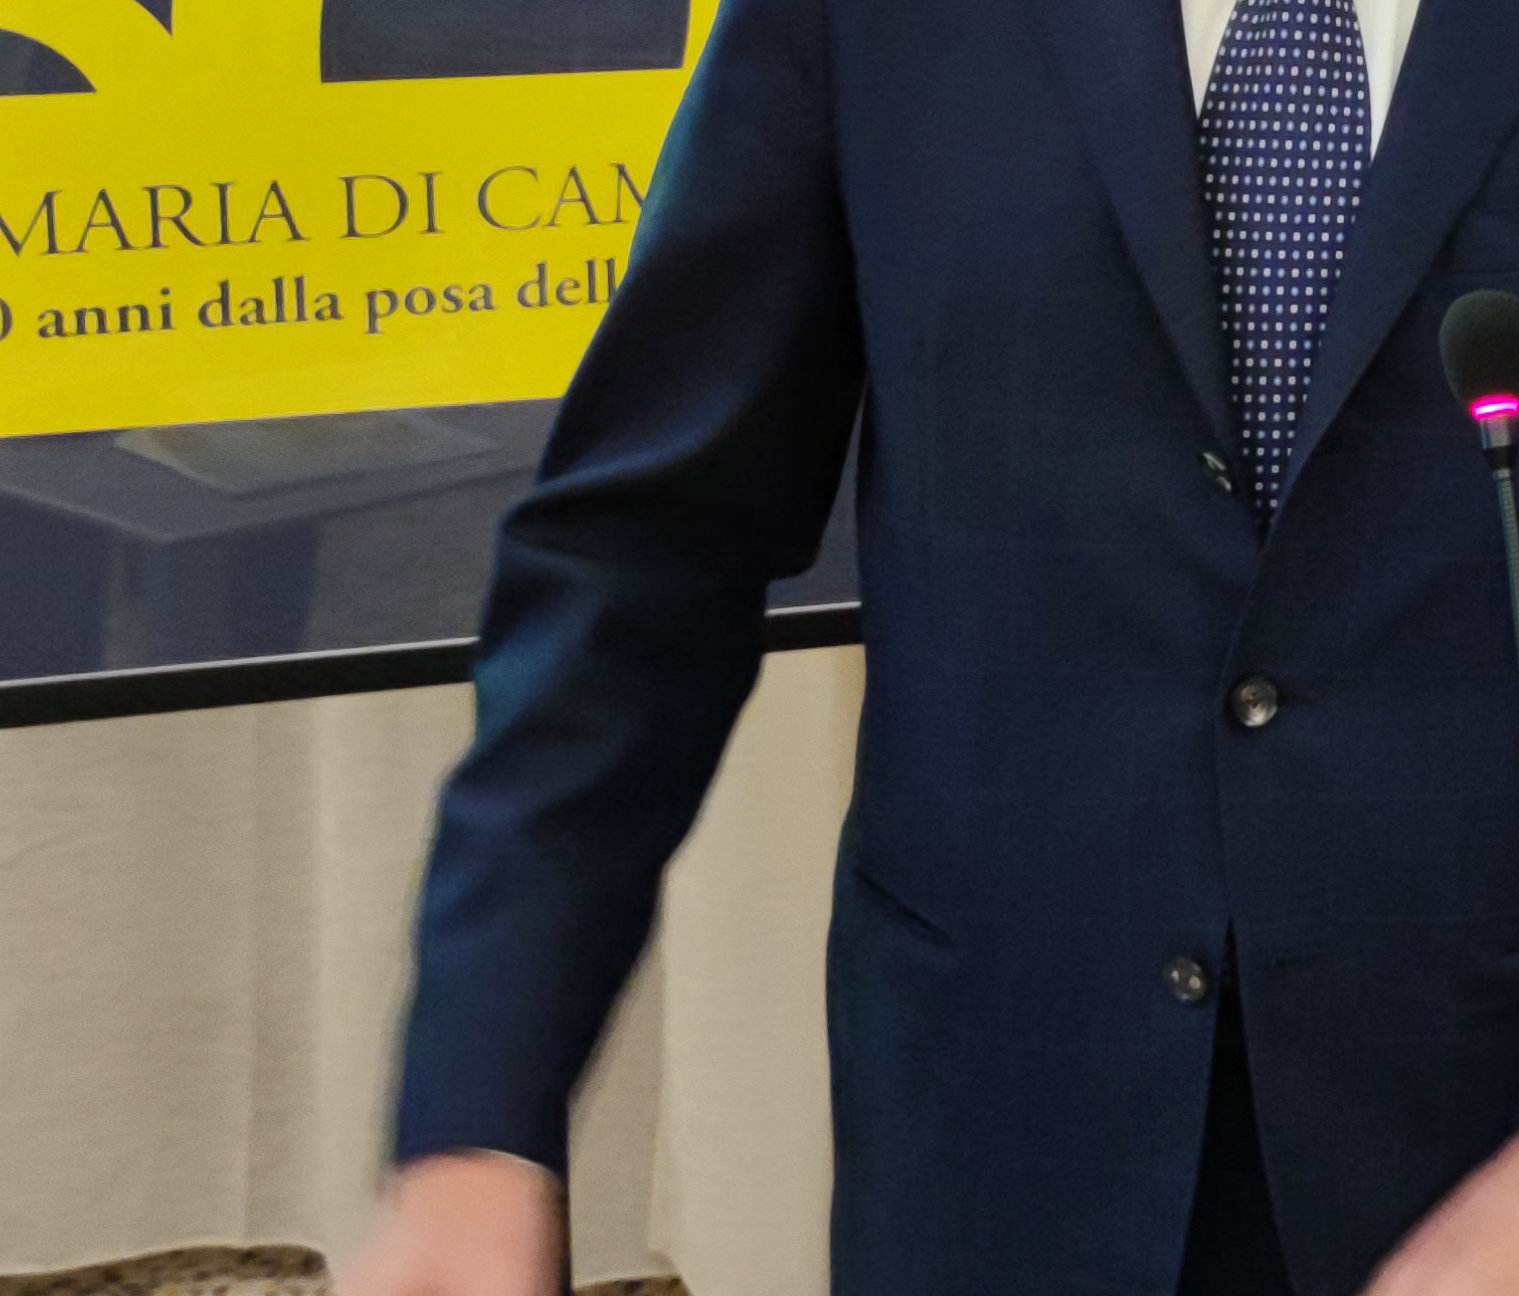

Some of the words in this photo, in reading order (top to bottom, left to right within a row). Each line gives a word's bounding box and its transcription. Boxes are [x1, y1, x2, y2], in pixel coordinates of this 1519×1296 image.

[339, 171, 444, 241] DI
[37, 286, 177, 339] anni
[197, 276, 343, 330] dalla
[364, 278, 497, 336] posa
